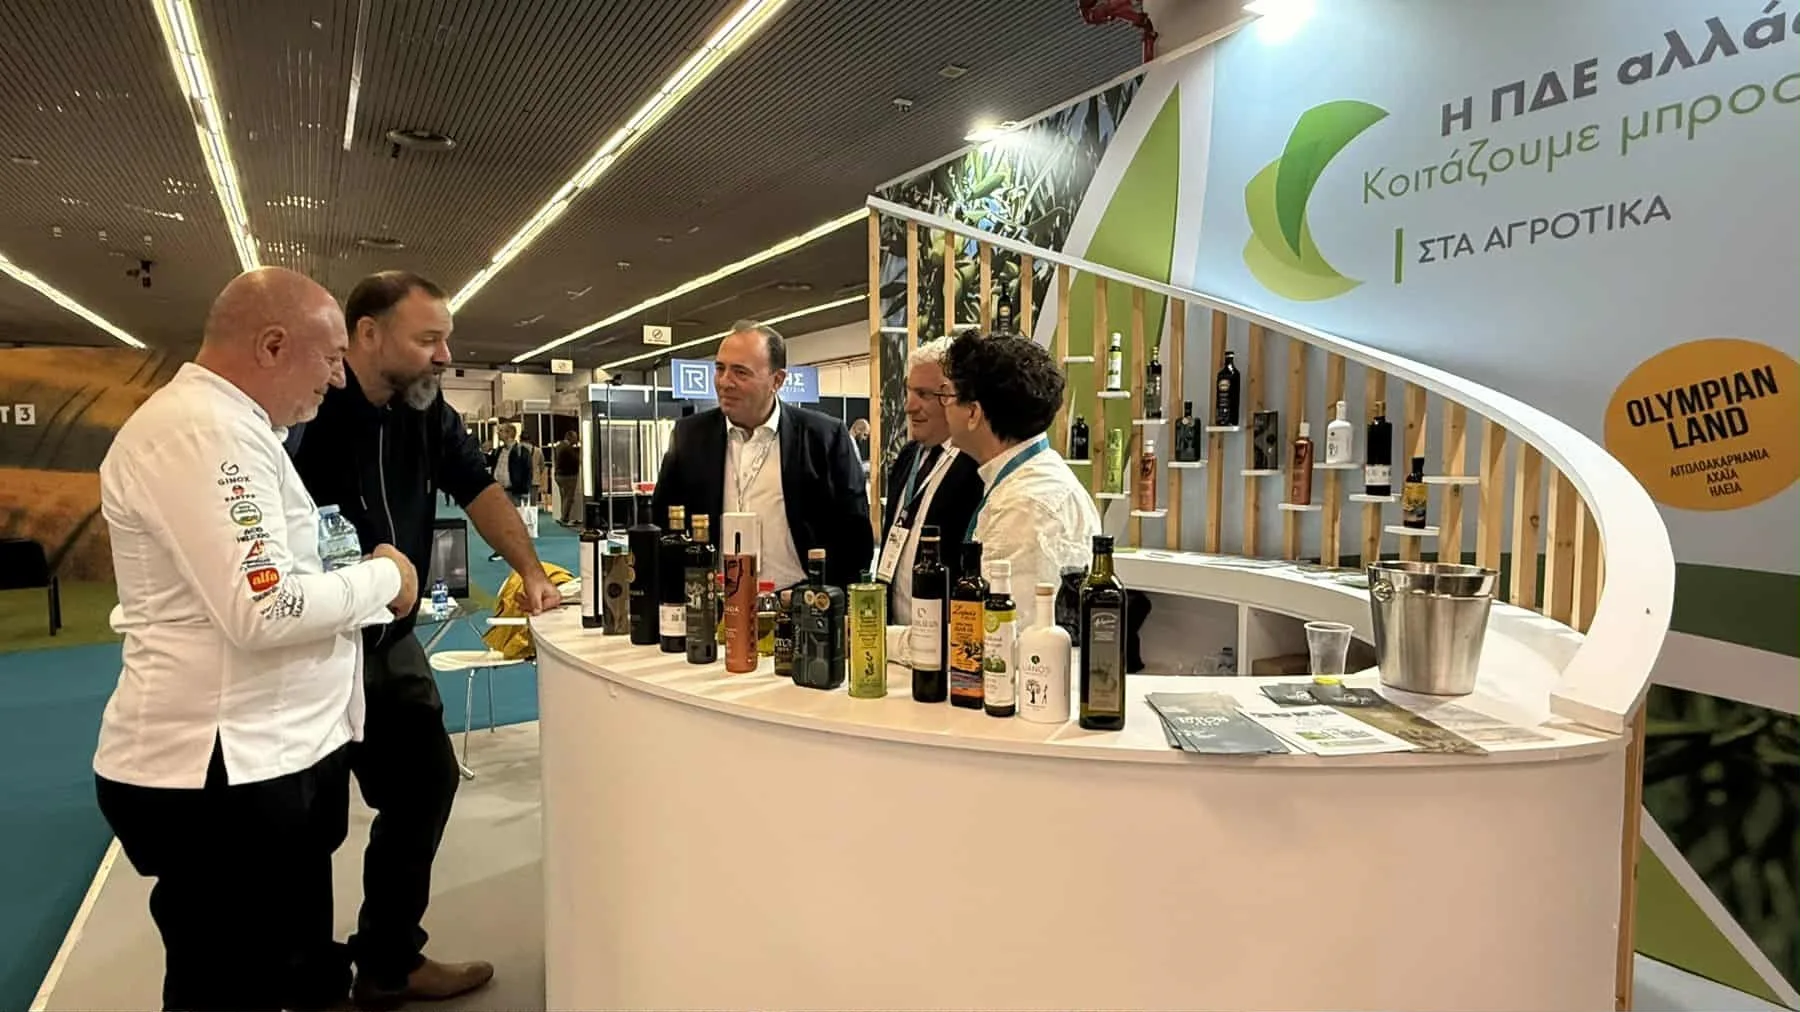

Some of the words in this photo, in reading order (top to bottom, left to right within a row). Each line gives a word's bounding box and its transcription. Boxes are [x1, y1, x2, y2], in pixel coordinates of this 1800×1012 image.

[1441, 97, 1472, 136] Η
[1491, 57, 1599, 122] ΠΔΕ
[1616, 0, 1800, 86] αλλά
[1363, 123, 1601, 204] Κοιτάζουμε
[1418, 233, 1475, 263] ΣΤΑ
[1483, 195, 1672, 253] ΑΓΡΟΤΙΚΑ
[20, 407, 31, 422] 3
[1626, 365, 1779, 428] OLYMPIAN
[1667, 407, 1750, 450] LAND
[1709, 482, 1743, 497] ΗΛΕΙΑ
[252, 569, 278, 586] alfa
